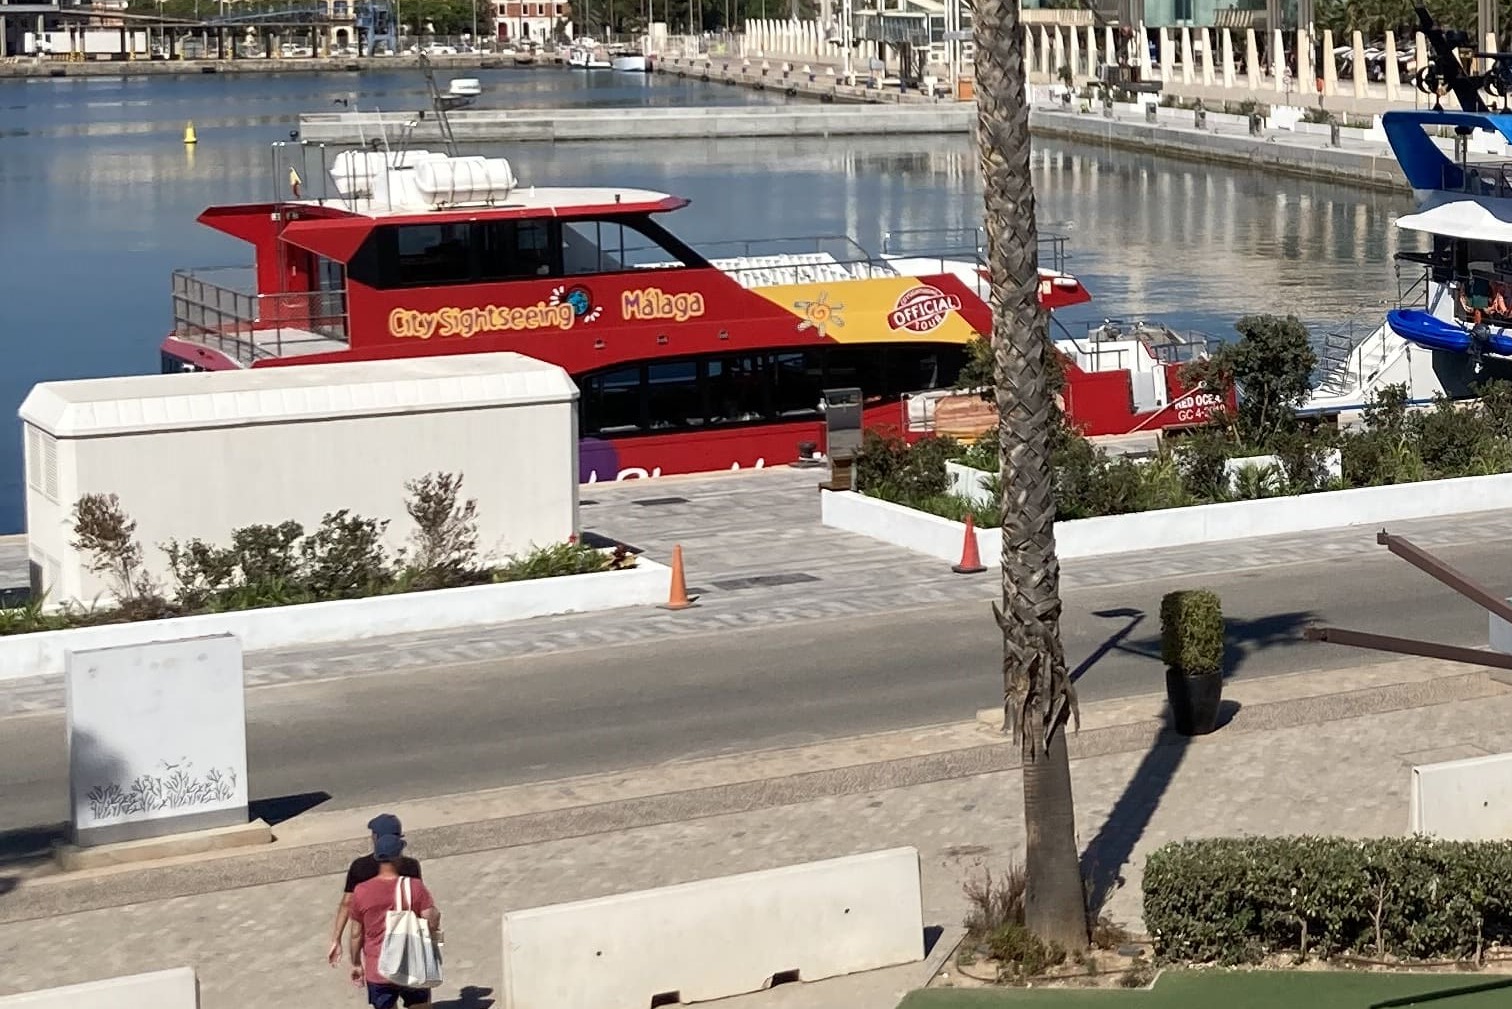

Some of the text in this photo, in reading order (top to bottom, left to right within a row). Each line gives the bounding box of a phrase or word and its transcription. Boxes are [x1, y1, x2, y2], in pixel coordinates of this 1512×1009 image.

[622, 288, 705, 322] Málaga
[893, 296, 956, 326] OFFICIAL
[915, 314, 942, 331] TOUR
